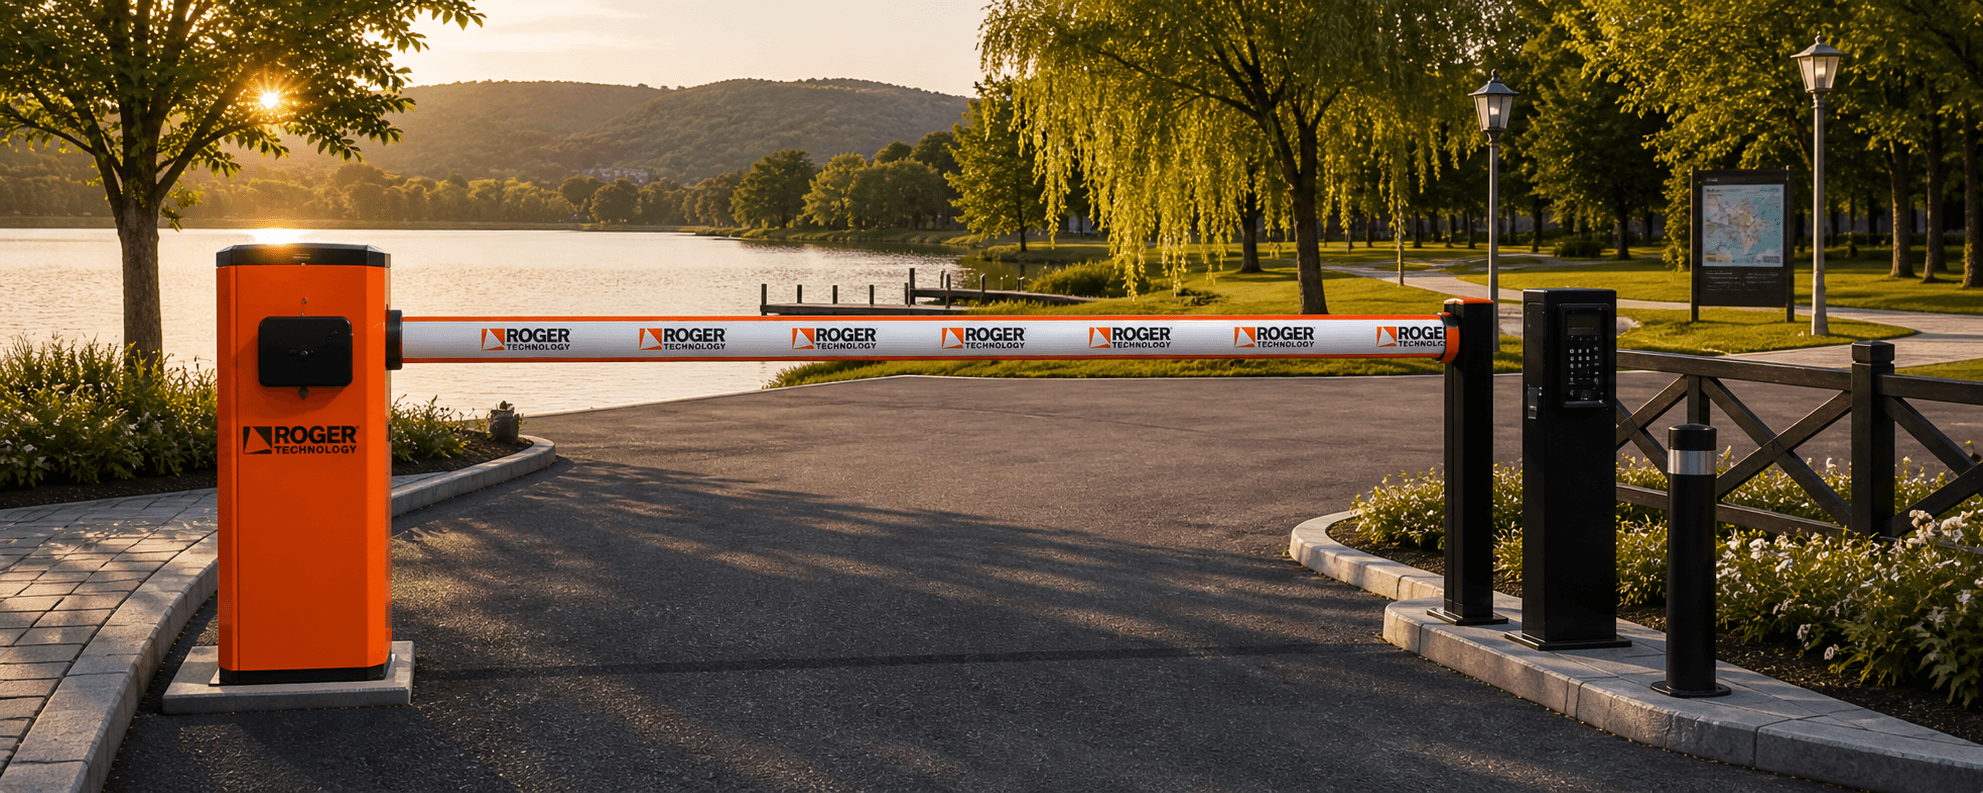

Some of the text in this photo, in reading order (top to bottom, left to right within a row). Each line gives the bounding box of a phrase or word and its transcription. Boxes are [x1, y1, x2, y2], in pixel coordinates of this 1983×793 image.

[507, 328, 570, 343] ROGER
[664, 328, 726, 343] ROGER
[816, 328, 877, 342] ROGER
[965, 327, 1025, 342] ROGER
[1112, 327, 1171, 341] ROGER
[1257, 326, 1315, 341] ROGER
[506, 343, 570, 351] TECHNOLOGY
[815, 342, 877, 350] TECHNOLOGY
[274, 425, 357, 444] ROGER
[274, 445, 357, 454] TECHNOLOGY
